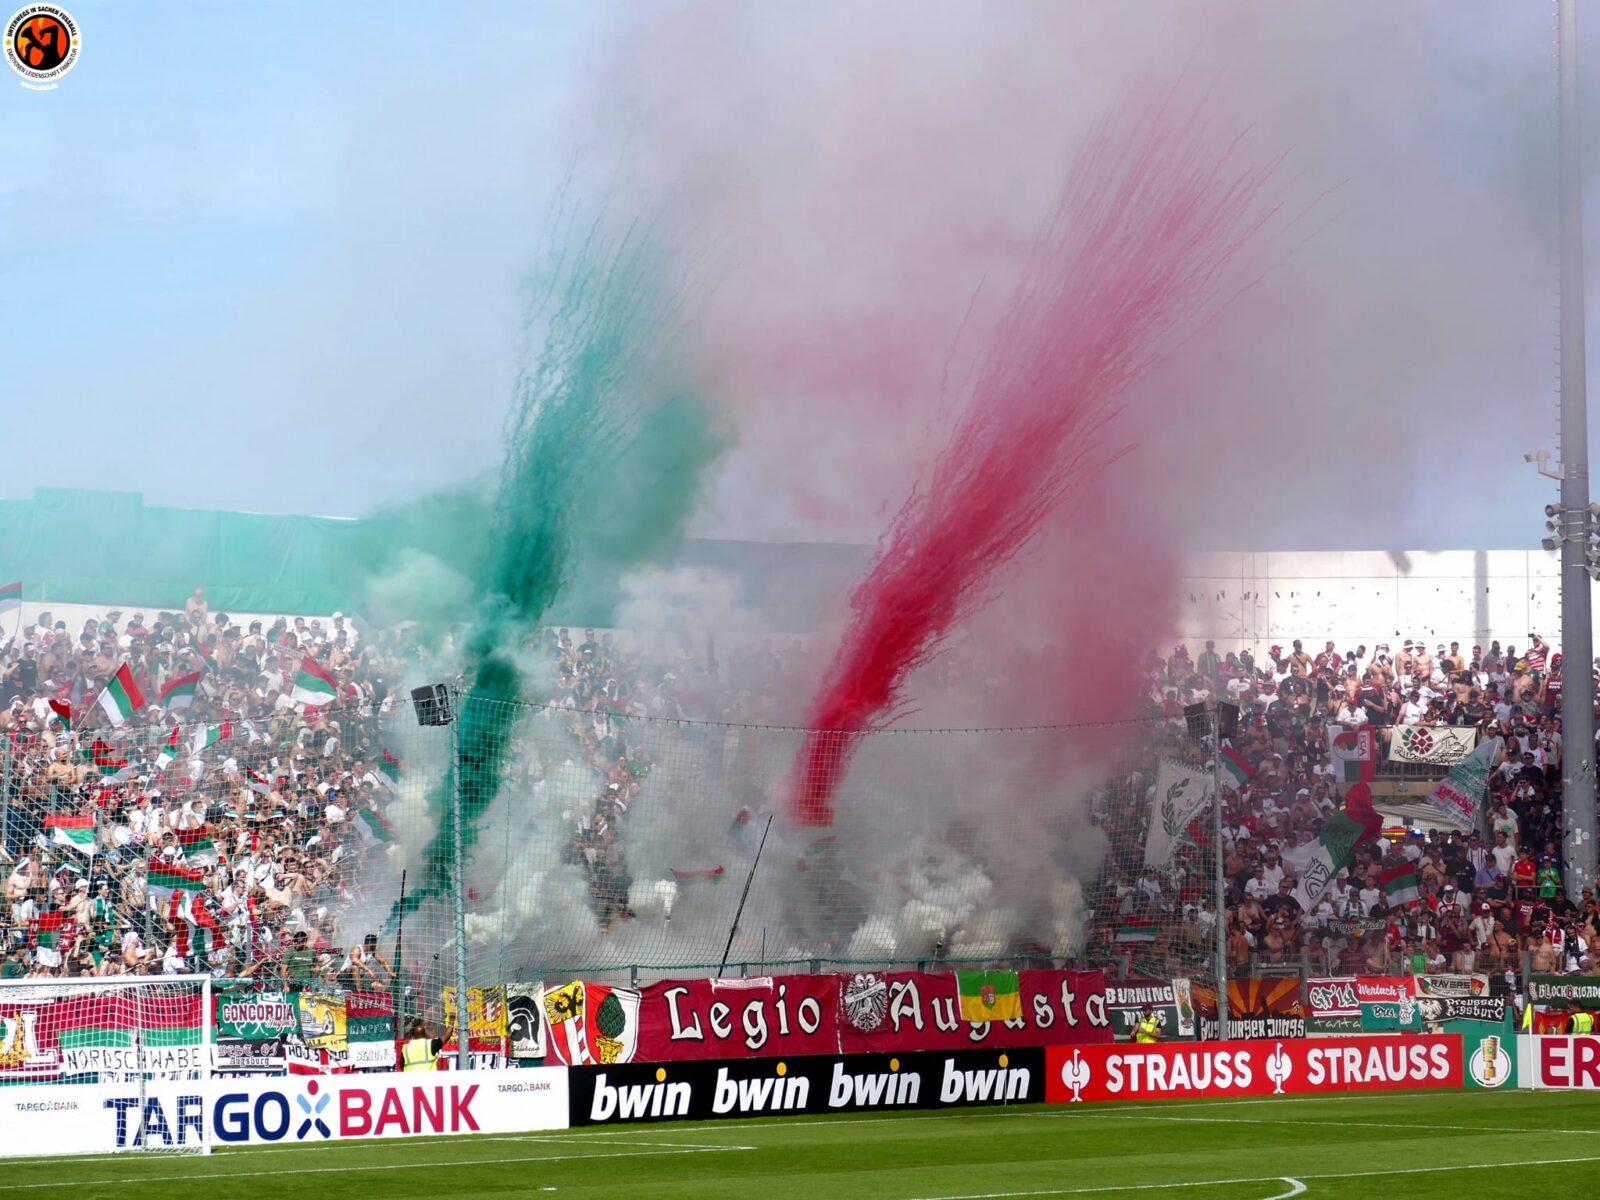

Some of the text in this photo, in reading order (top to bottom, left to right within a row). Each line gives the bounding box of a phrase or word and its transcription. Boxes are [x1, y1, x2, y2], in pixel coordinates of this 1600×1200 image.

[223, 1003, 295, 1022] CONCORDIA
[1105, 986, 1173, 1004] BURNING
[664, 984, 821, 1050] Legio
[230, 1057, 269, 1067] Augsburg
[828, 1058, 921, 1107] bwin
[940, 1053, 1030, 1103] bwin
[1105, 1050, 1252, 1093] STRAUSS
[1307, 1044, 1450, 1085] STRAUSS
[15, 1101, 78, 1112] TARGO BANK
[498, 1083, 551, 1093] TARGO BANK
[590, 1067, 692, 1121] bwin
[712, 1062, 810, 1113] bwin
[103, 1084, 480, 1148] TARGO BANK
